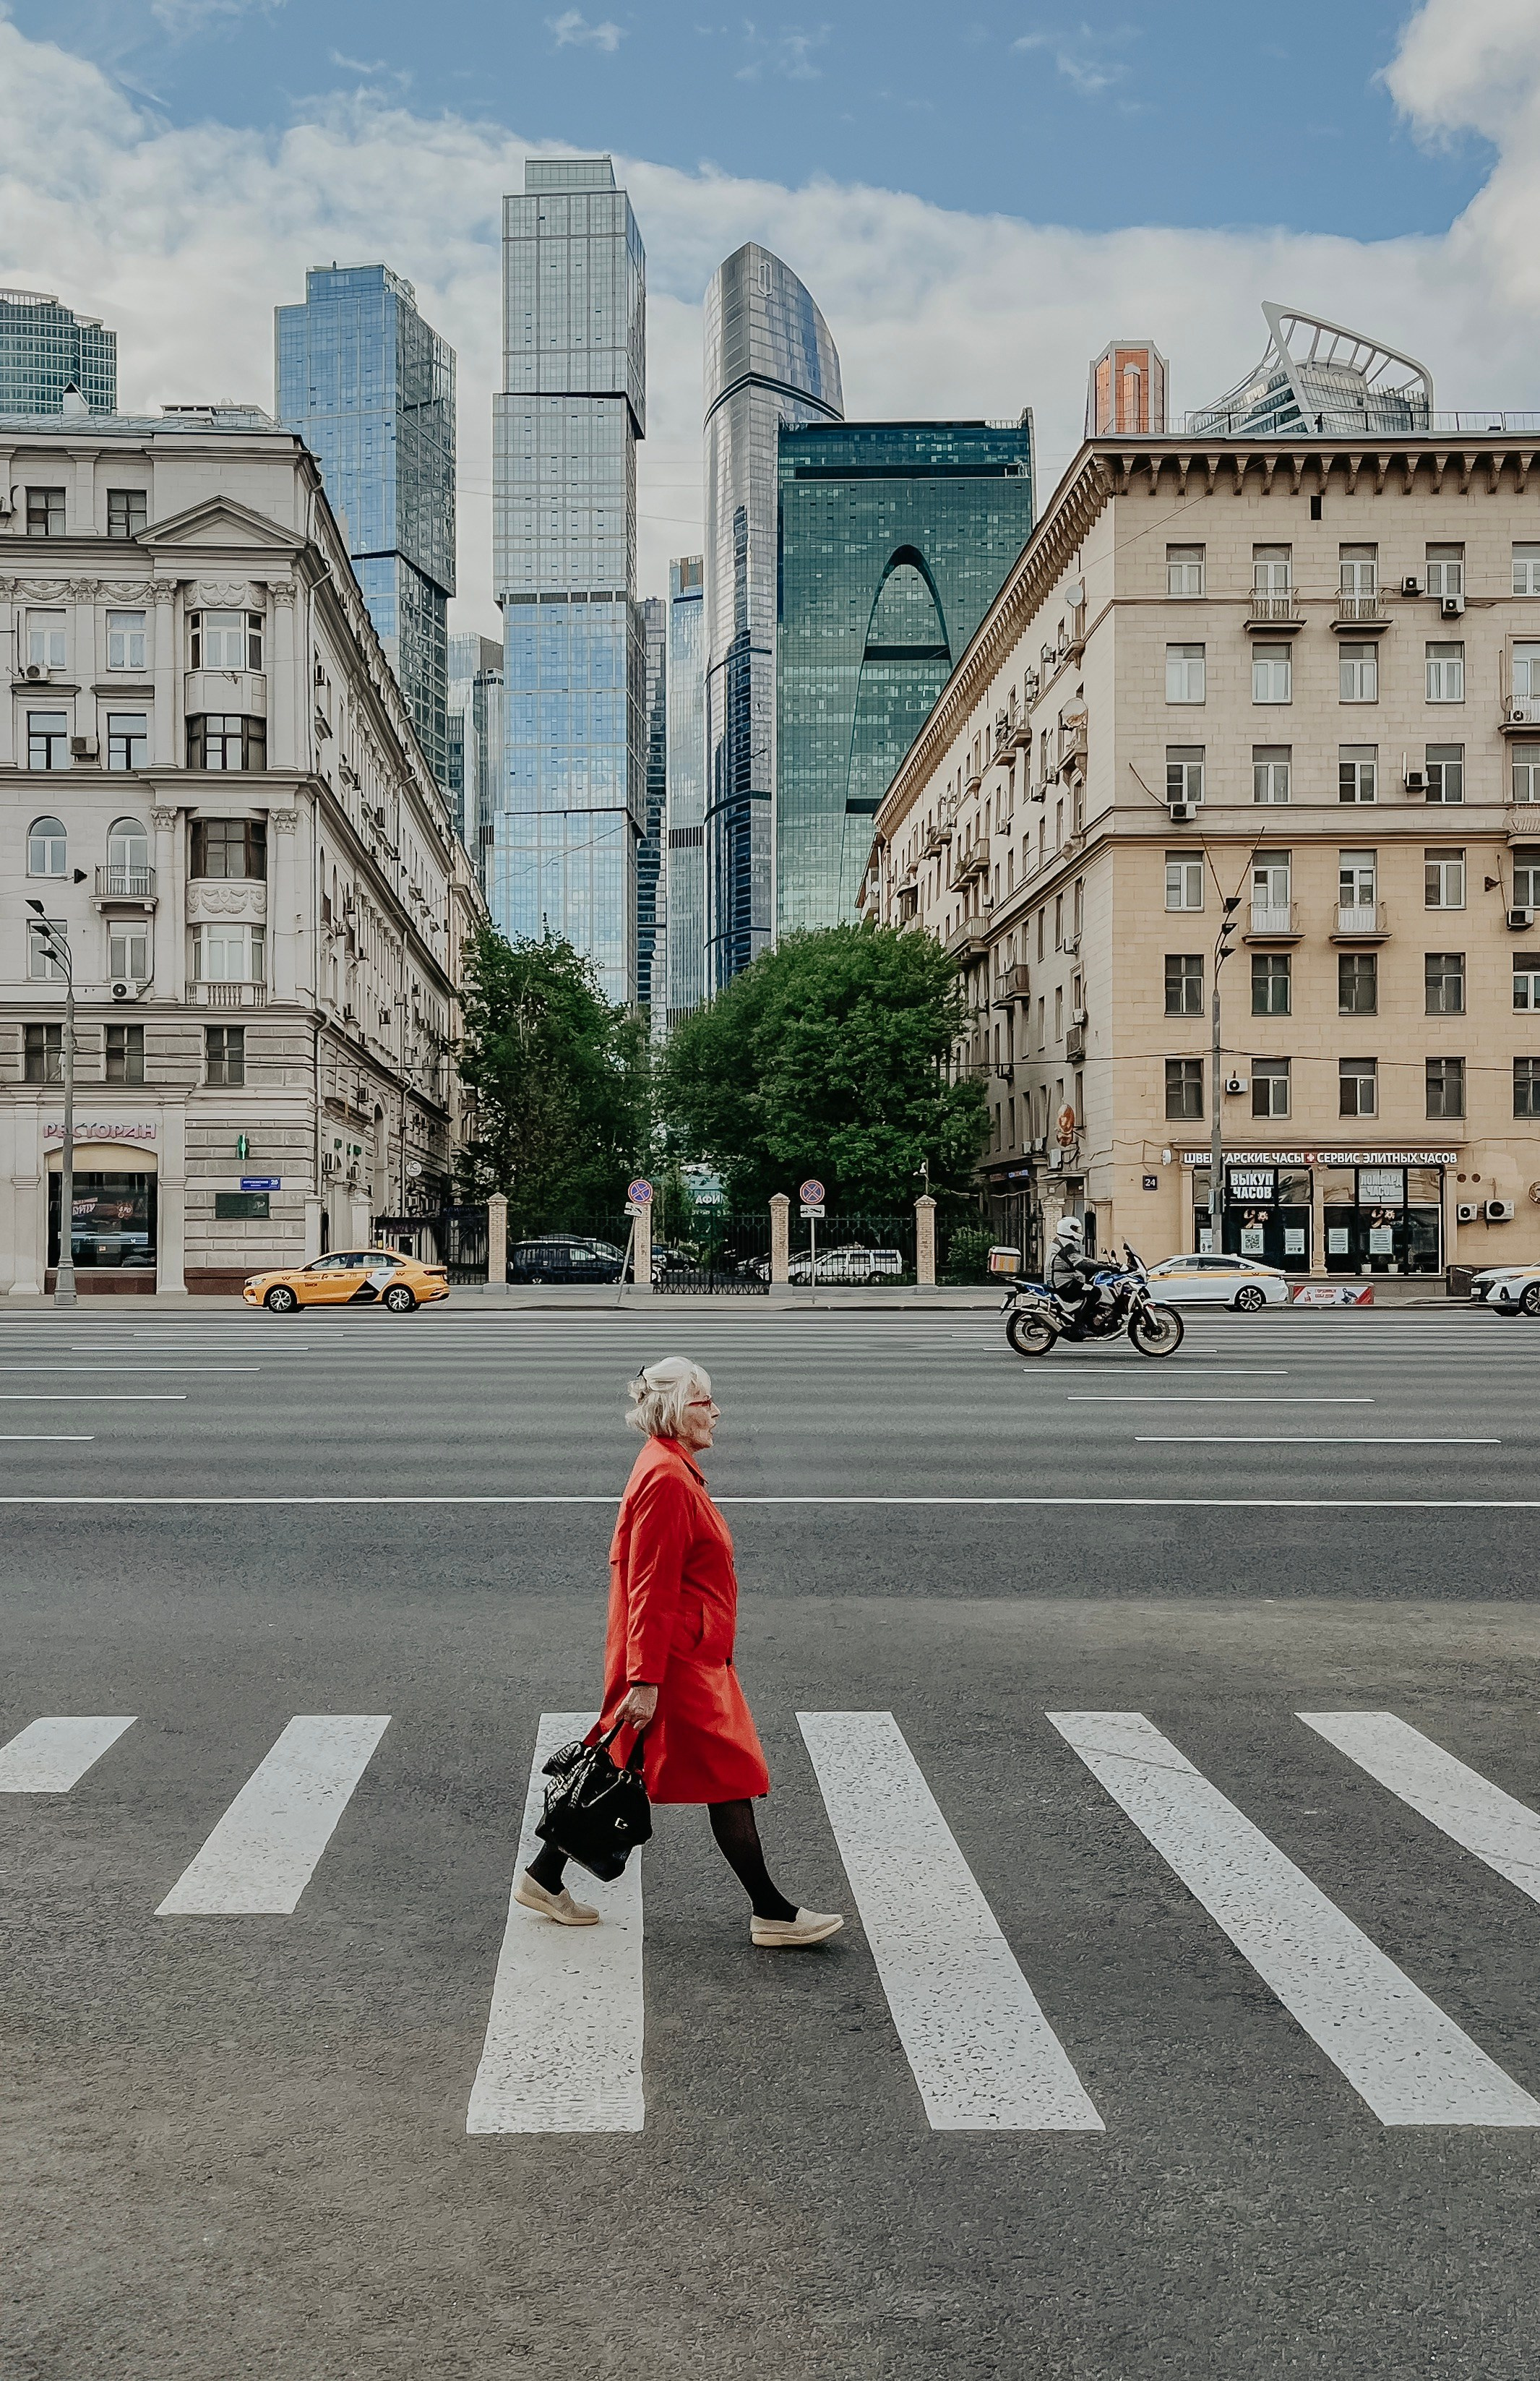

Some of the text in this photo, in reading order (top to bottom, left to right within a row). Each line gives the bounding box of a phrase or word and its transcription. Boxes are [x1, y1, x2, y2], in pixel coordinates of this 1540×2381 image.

[1184, 1152, 1458, 1164] ШВЕАРСКИЕ ЧАСЫ СЕРВИС ЭЛИТНЫХ ЧАСОВ
[1145, 1178, 1156, 1187] 24
[1230, 1173, 1274, 1186] ВЫКУП
[1360, 1175, 1403, 1186] ЛОМБАРД
[1233, 1186, 1273, 1199] ЧАСОВ
